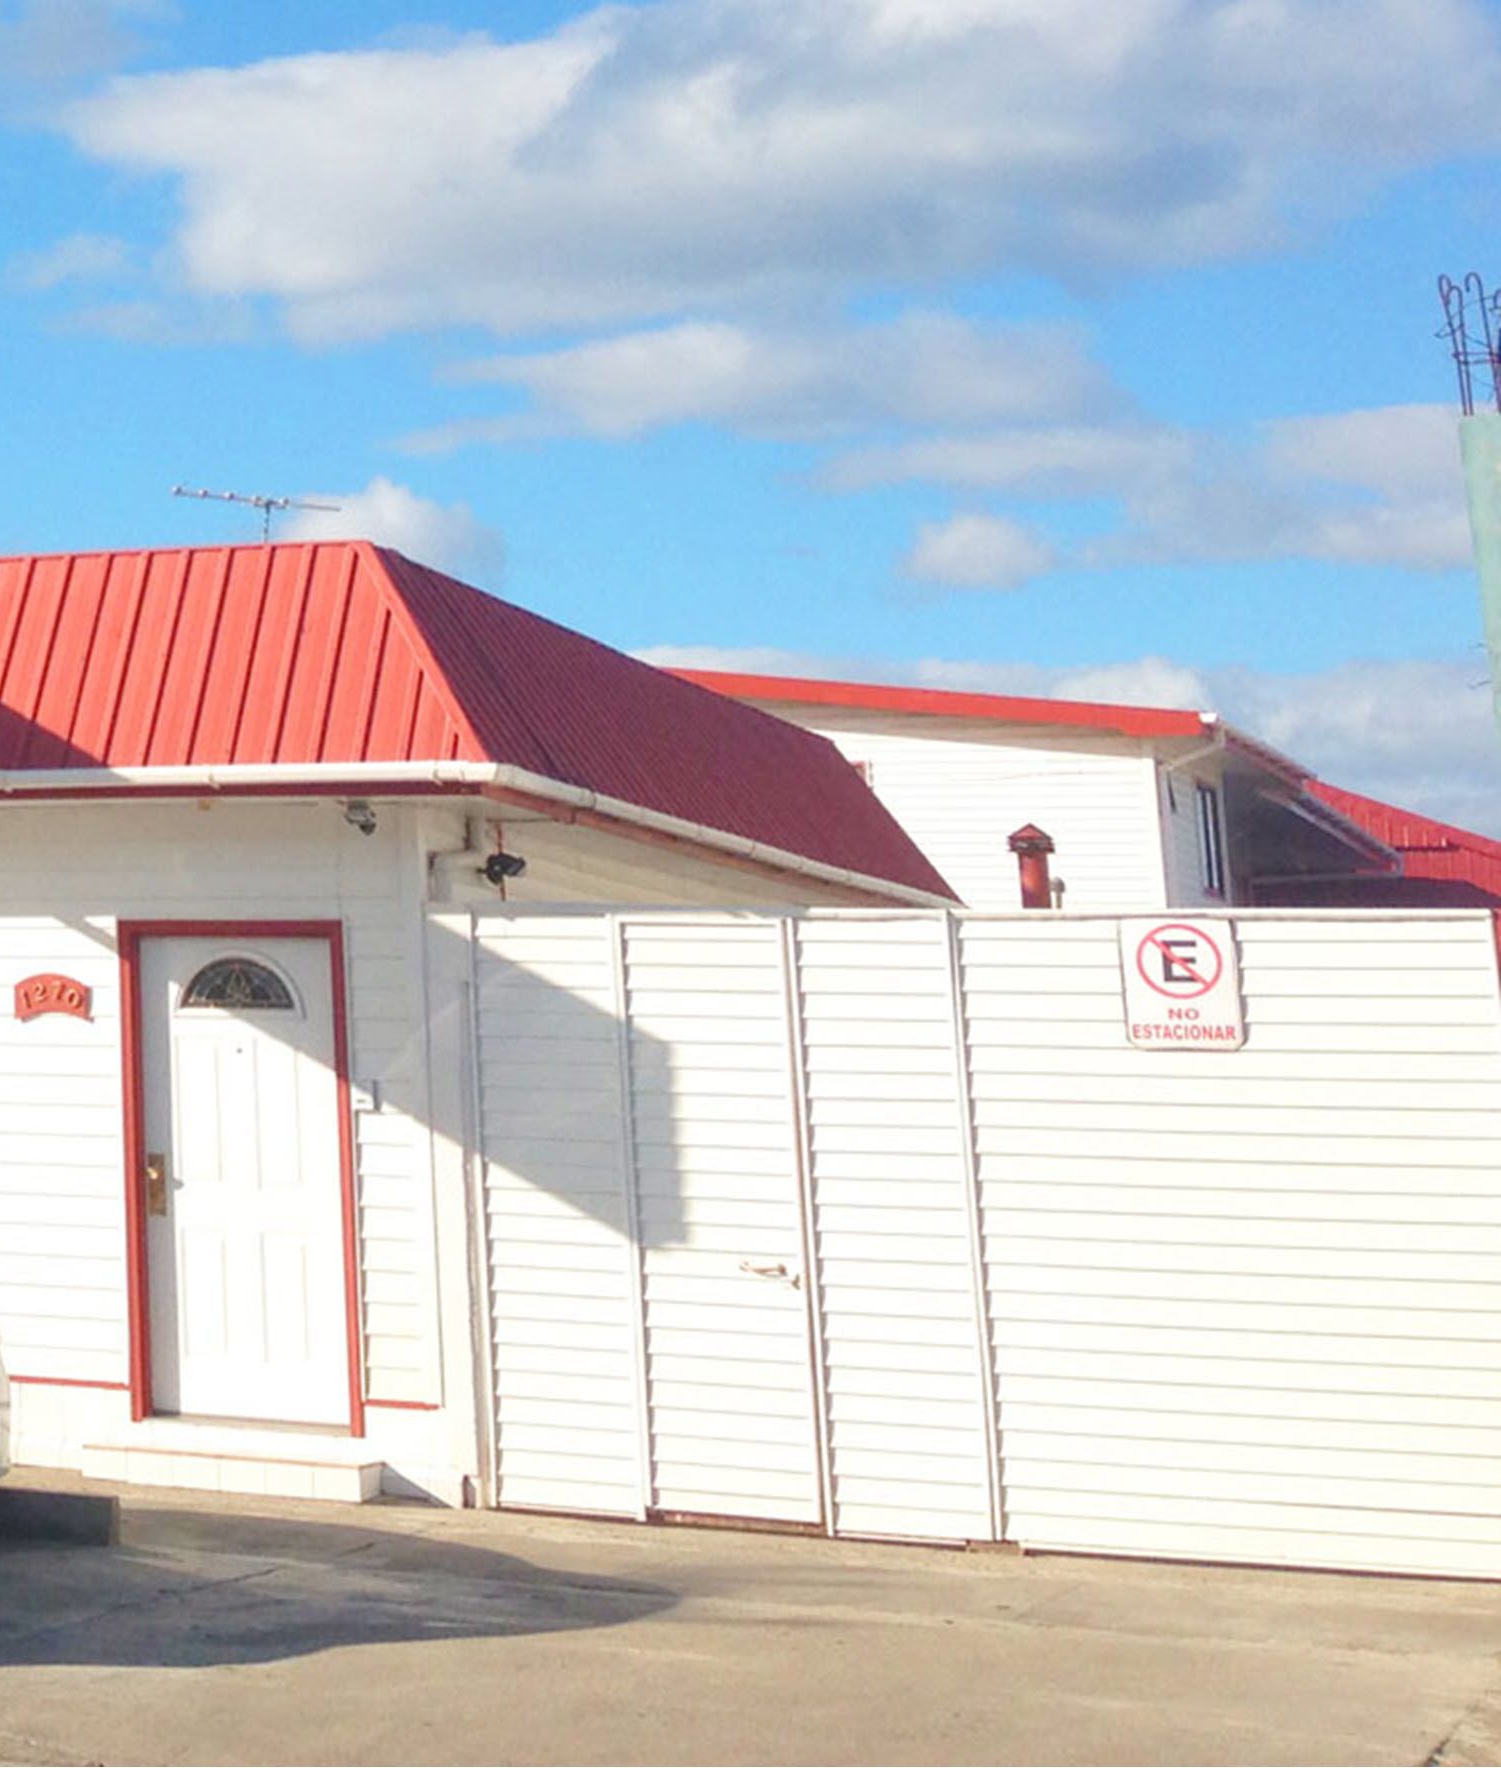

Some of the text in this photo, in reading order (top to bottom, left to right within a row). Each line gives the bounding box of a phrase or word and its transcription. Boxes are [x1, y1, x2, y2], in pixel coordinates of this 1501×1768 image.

[20, 980, 84, 1010] 1270
[1167, 1007, 1200, 1021] NO
[1132, 1023, 1236, 1041] ESTACIONAR
